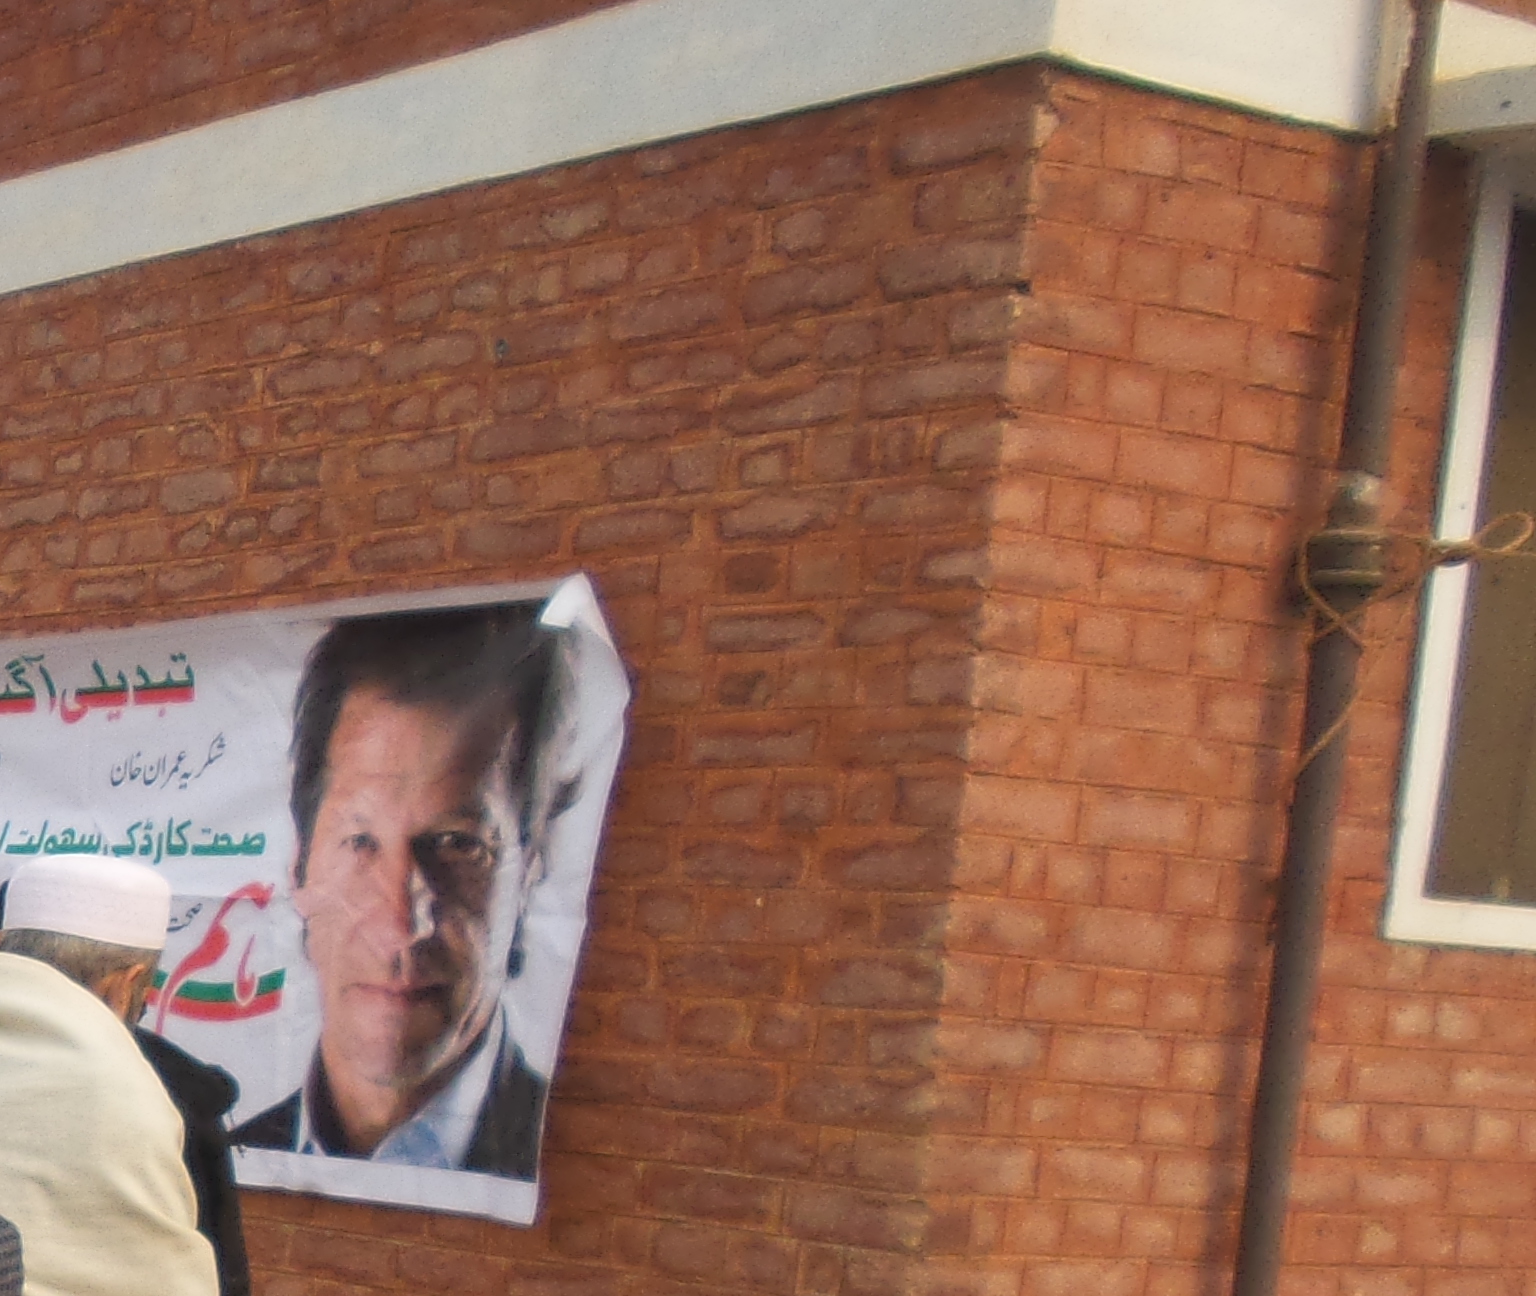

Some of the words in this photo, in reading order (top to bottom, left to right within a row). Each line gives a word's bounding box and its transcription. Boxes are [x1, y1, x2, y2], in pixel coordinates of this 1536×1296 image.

[60, 652, 196, 725] تبدیلی
[110, 751, 142, 788] خان
[191, 827, 267, 857] صحت
